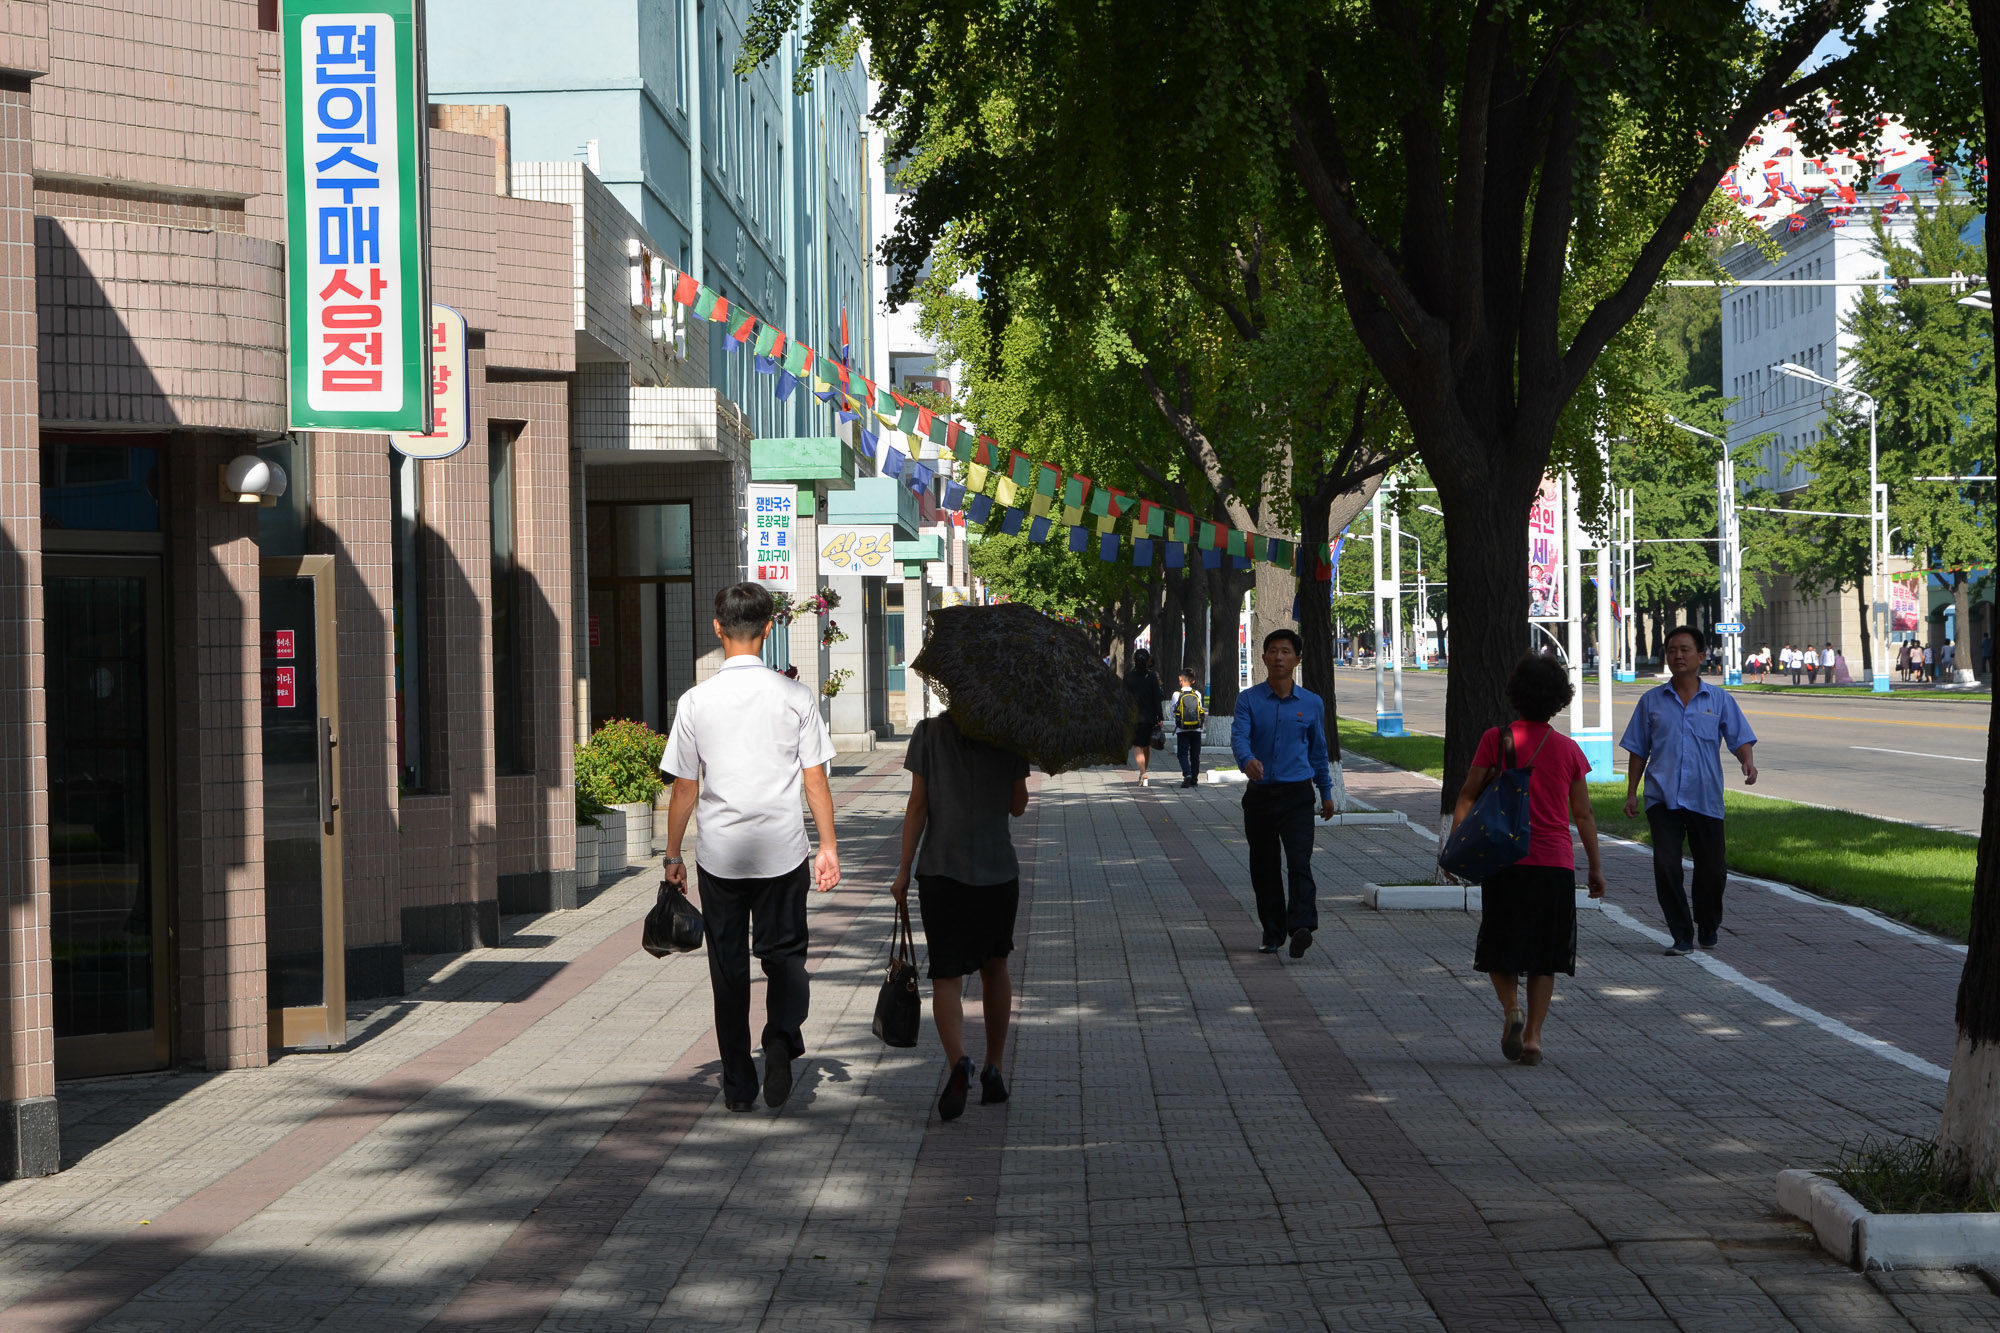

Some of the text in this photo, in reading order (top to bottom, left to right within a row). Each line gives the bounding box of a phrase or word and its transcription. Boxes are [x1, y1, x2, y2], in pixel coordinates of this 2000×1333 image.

[315, 25, 387, 392] 편의수매상점
[756, 496, 791, 512] 쟁반국수
[757, 515, 790, 528] 토장국밥
[757, 549, 790, 562] 꼬치구이
[821, 531, 891, 568] 식당
[1532, 538, 1548, 564] 세
[758, 565, 789, 580] 불고기
